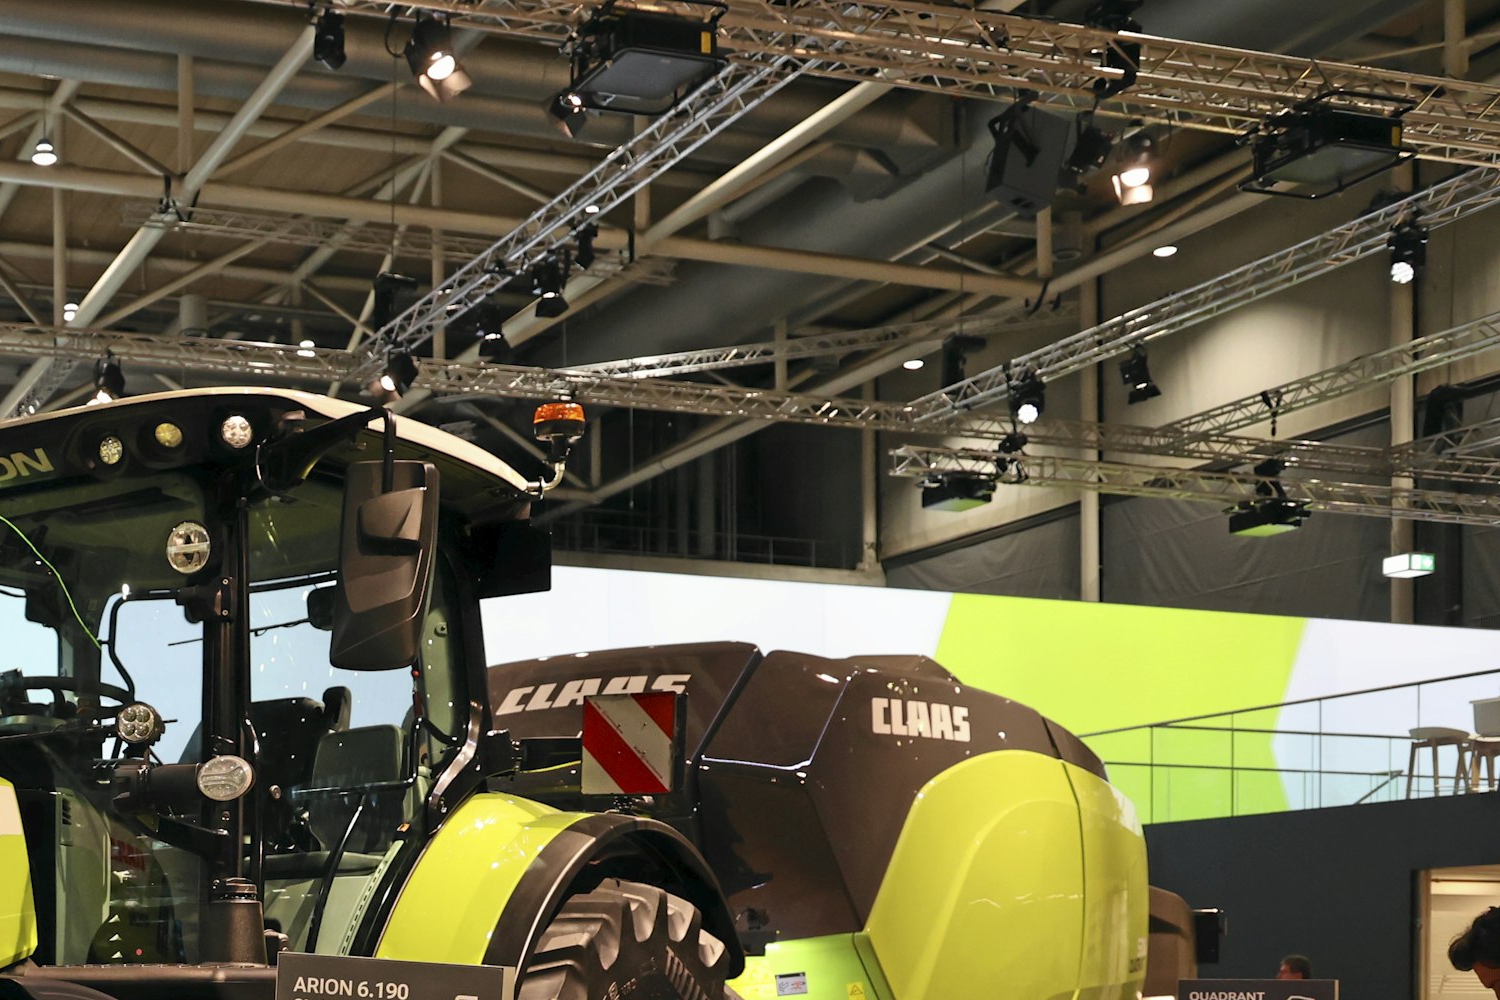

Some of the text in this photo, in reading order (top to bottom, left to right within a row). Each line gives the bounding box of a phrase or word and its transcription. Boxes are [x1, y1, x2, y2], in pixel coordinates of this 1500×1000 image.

[495, 674, 692, 716] CLAAS
[872, 697, 970, 742] CLAAS
[293, 976, 409, 1000] ARION 6.190
